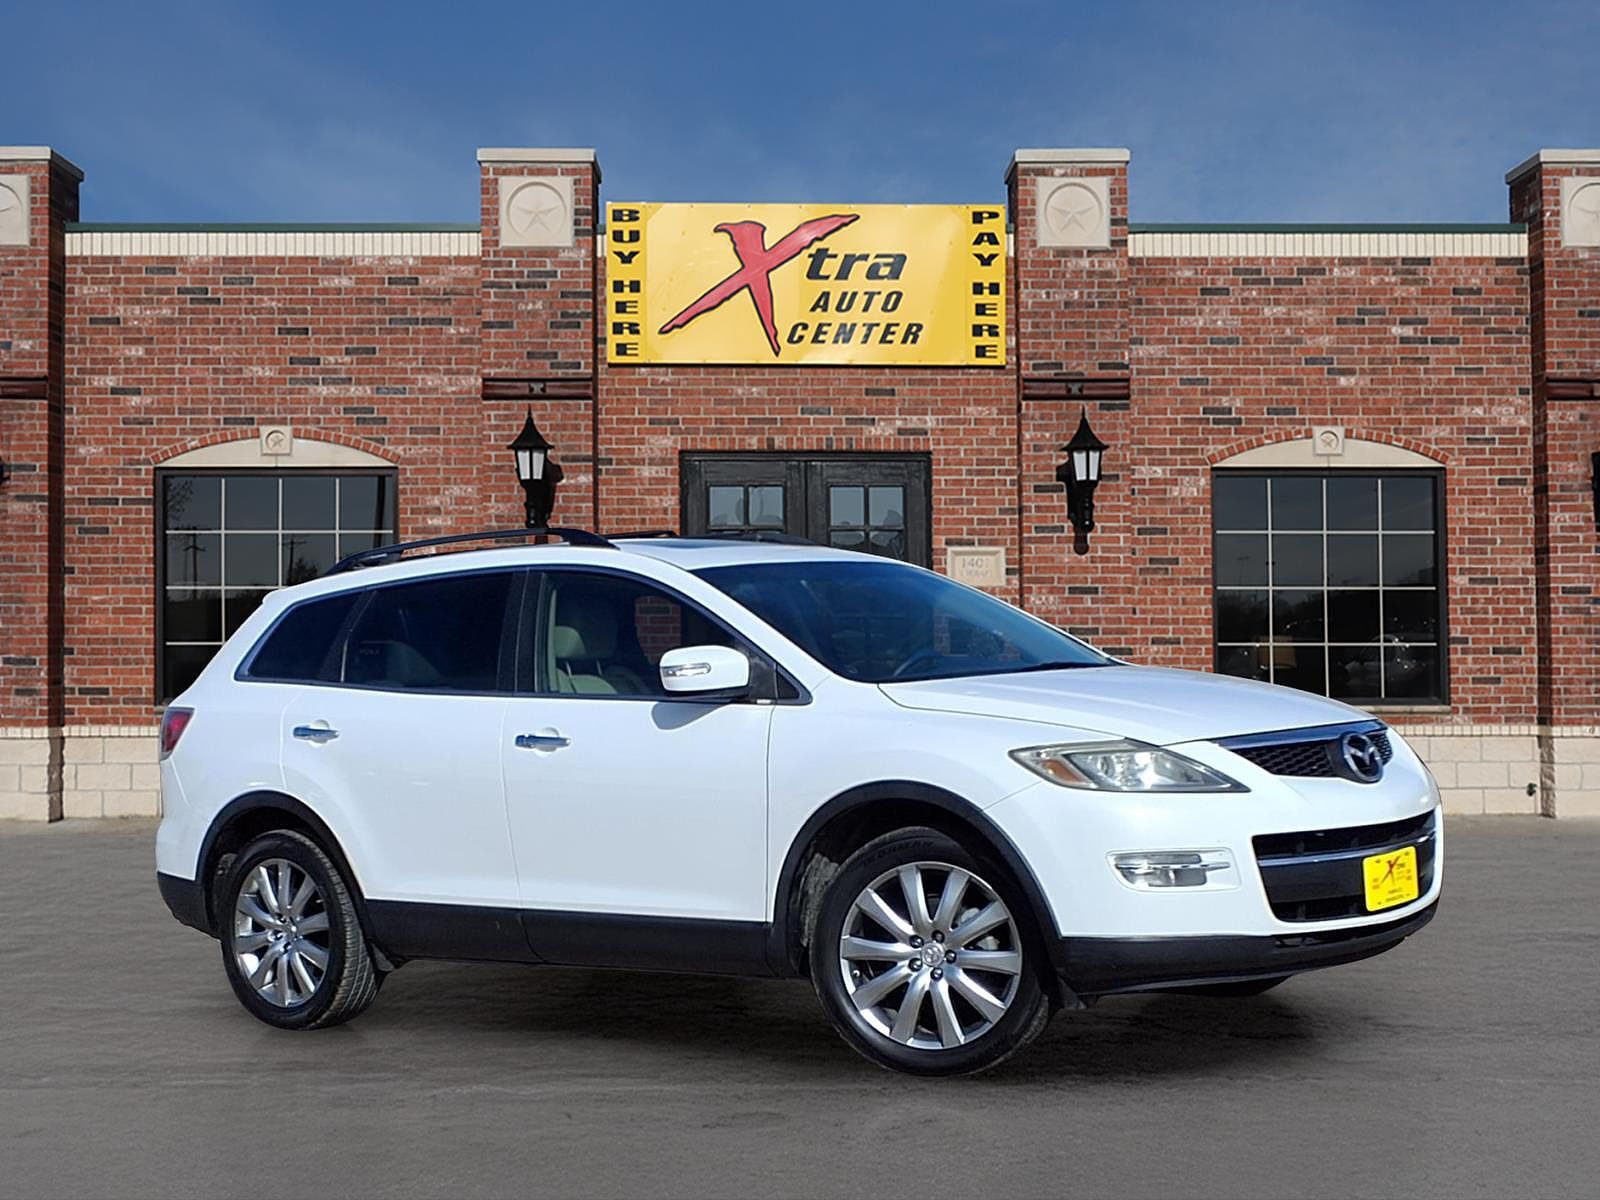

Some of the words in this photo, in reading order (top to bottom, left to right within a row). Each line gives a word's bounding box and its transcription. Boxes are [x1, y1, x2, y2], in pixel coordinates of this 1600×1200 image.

[612, 208, 640, 264] BUY
[972, 211, 1000, 267] PAY
[612, 280, 640, 357] HERE
[810, 290, 903, 313] AUTO
[972, 282, 1000, 359] HERE
[786, 322, 924, 345] CENTER
